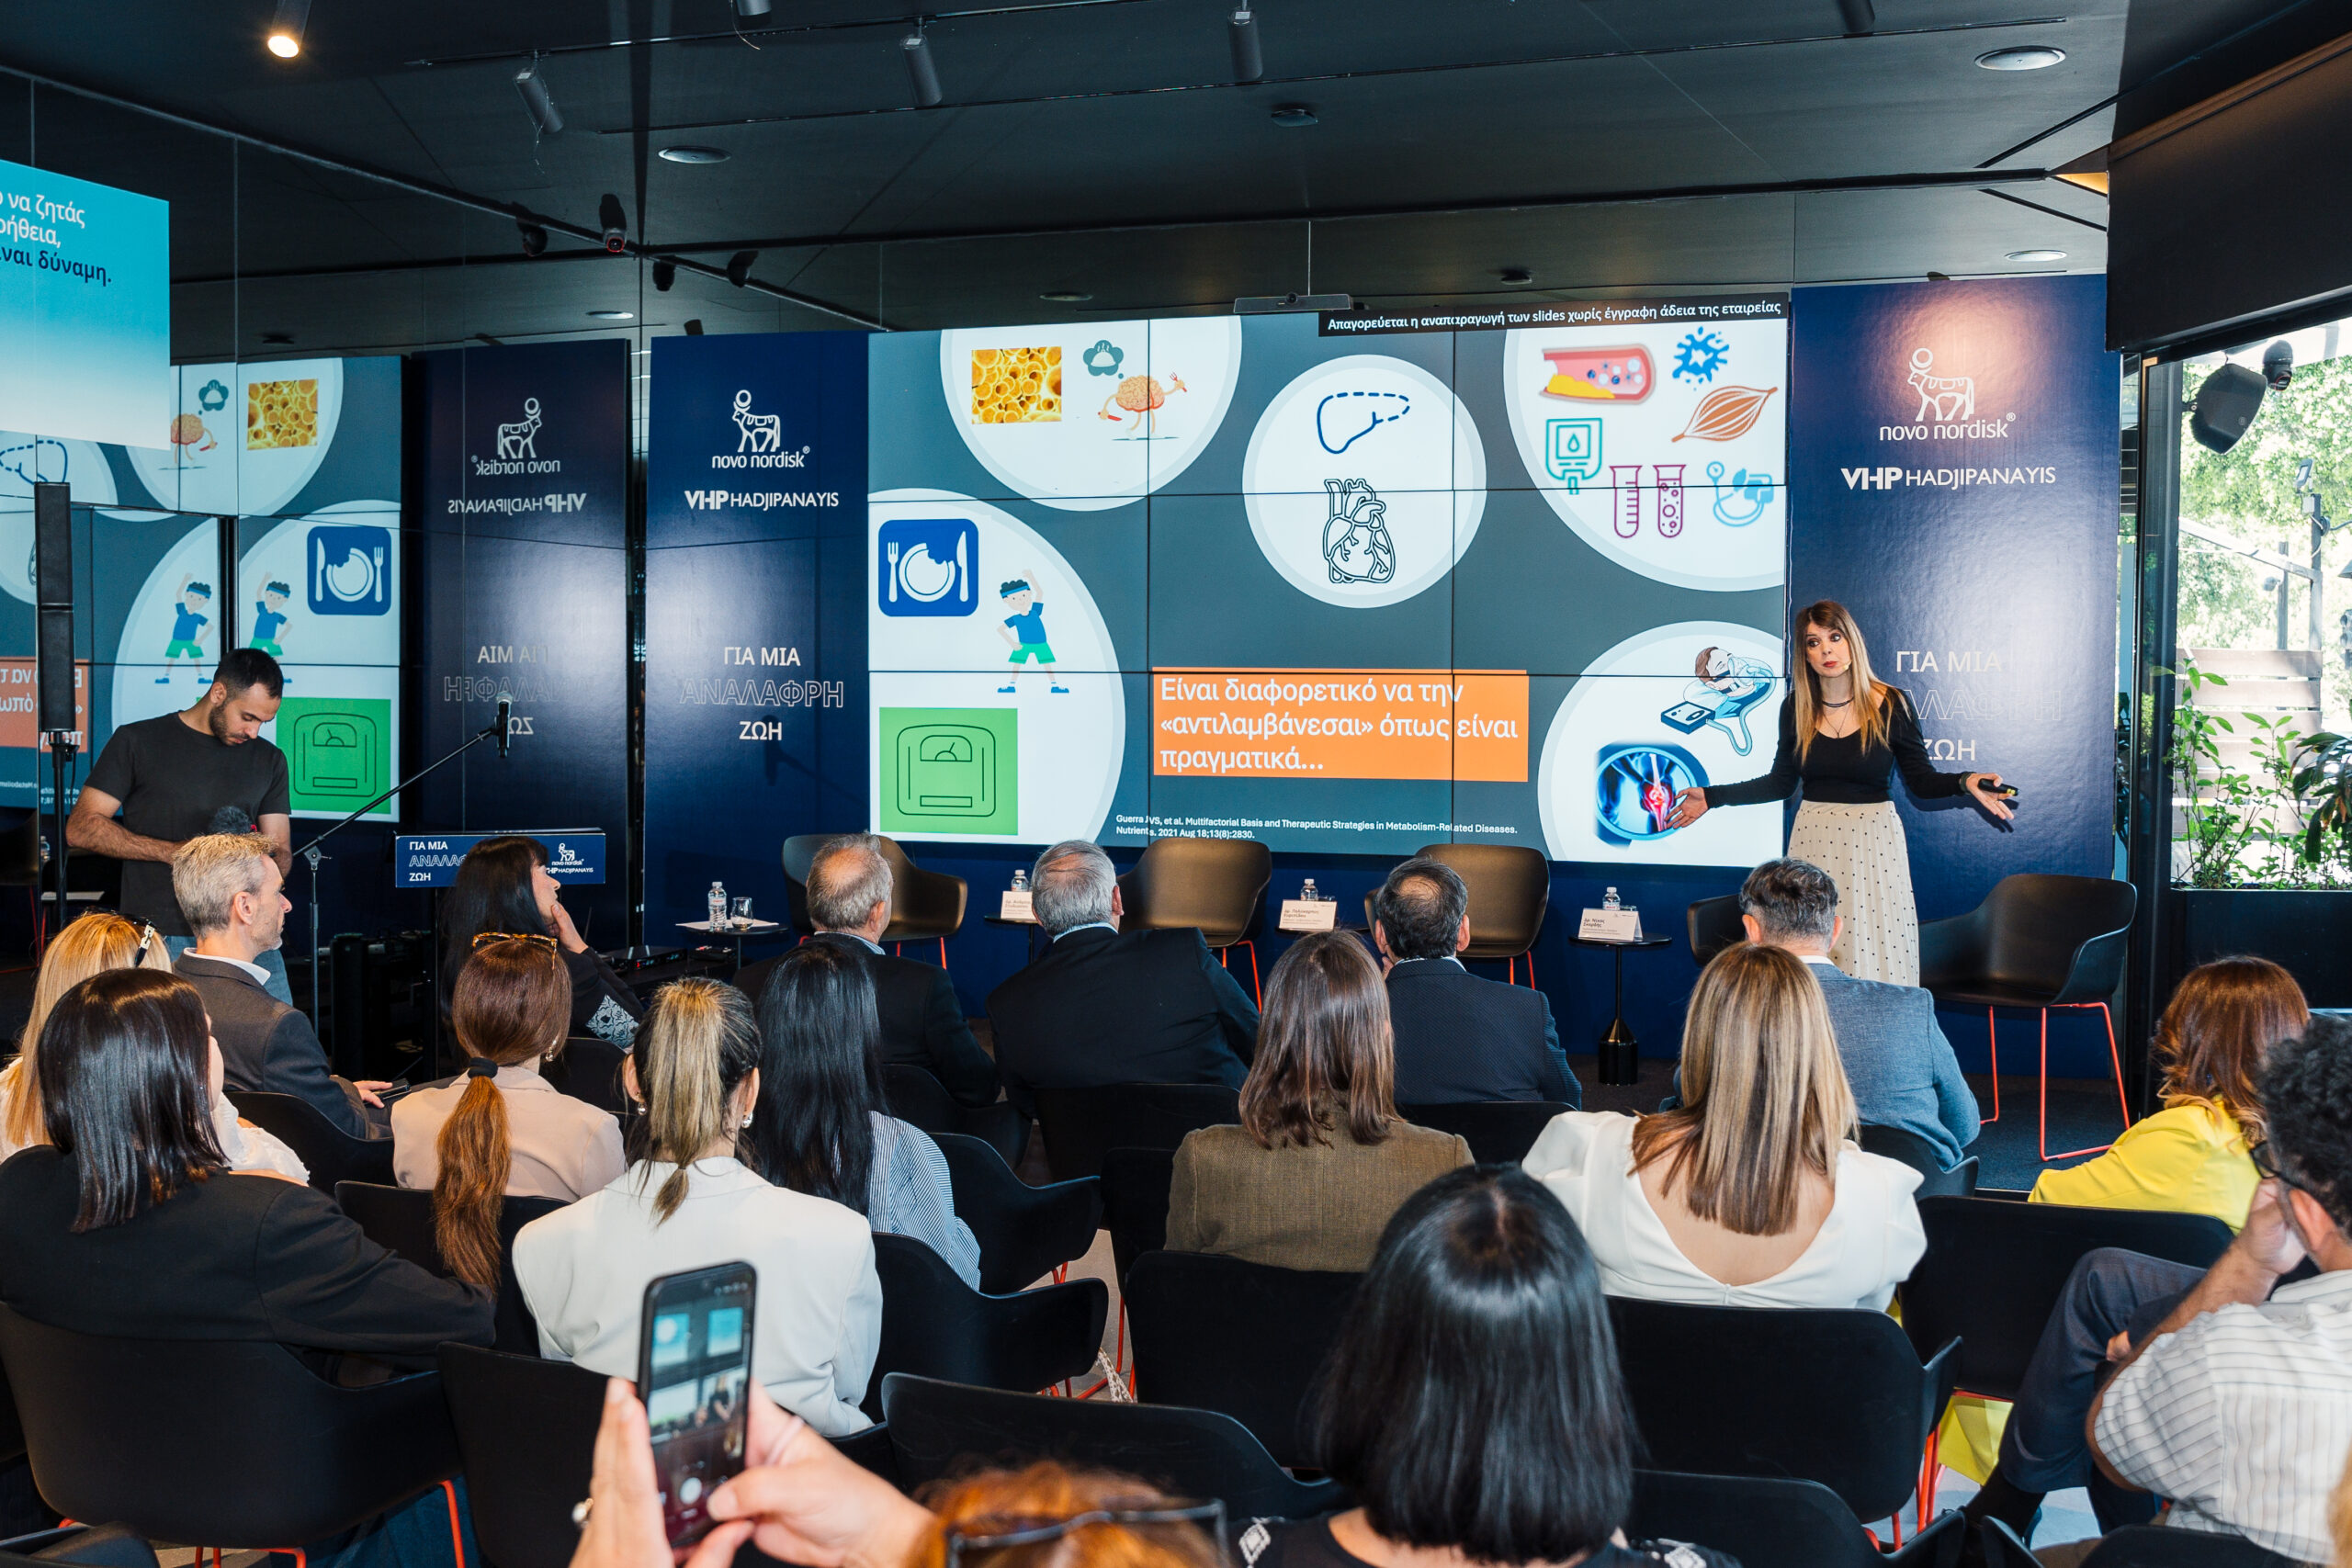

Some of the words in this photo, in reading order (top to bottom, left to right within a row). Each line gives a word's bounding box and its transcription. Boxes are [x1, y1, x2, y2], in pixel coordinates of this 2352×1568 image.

[7, 193, 31, 212] να
[35, 194, 85, 229] ζητάς
[0, 246, 33, 267] ναι
[39, 250, 112, 287] δύναμη.
[1328, 315, 1408, 332] Απαγορεύεται
[1410, 318, 1419, 330] η
[1420, 310, 1505, 328] αναπαραγωγή
[1508, 312, 1531, 322] των
[1532, 309, 1565, 321] slides
[1567, 307, 1601, 322] χωρίς
[1604, 306, 1657, 321] έγγραφη
[1660, 303, 1696, 317] άδεια
[1698, 305, 1719, 317] της
[1722, 300, 1781, 315] εταιρείας
[1880, 424, 1928, 441] novo
[712, 455, 747, 468] novo
[1840, 467, 1904, 491] VHP
[1905, 467, 2056, 491] HADJIPANAYIS
[684, 490, 729, 510] VHP
[730, 492, 839, 512] HADJIPANAYIS
[724, 647, 755, 665] ΓΙΑ
[761, 647, 801, 666] ΜΙΑ
[1896, 650, 1939, 672] ΓΙΑ
[1948, 650, 2002, 672] ΜΙΑ
[679, 678, 843, 708] ΑΝΑΛΑΦΡΗ
[1161, 678, 1219, 702] Είναι
[1225, 678, 1377, 706] διαφορετικό
[1383, 684, 1413, 702] να
[1419, 684, 1464, 707] την
[739, 721, 782, 740] ΖΩΗ
[1160, 713, 1374, 740] «αντιλαμβάνεσαι»
[1380, 713, 1450, 740] όπως
[1456, 715, 1518, 739] είναι
[1160, 746, 1324, 773] πραγματικά...
[1116, 814, 1144, 824] Guerra
[1164, 817, 1172, 825] et
[1173, 817, 1183, 826] al.
[1185, 818, 1239, 827] Multifactorial
[1241, 818, 1263, 828] Basis
[1264, 818, 1280, 828] and
[1282, 818, 1331, 830] Therapeutic
[1332, 820, 1374, 831] Strategies
[1376, 821, 1384, 830] in
[1385, 821, 1473, 832] Metabolism-Related
[1475, 824, 1518, 834] Diseases.
[1116, 826, 1157, 837] Nutrients.
[1158, 828, 1178, 838] 2021
[1180, 829, 1195, 840] Aug
[409, 841, 426, 851] ΓΙΑ
[428, 840, 448, 851] ΜΙΑ
[409, 854, 467, 867] ΑΝΑΛΑ
[409, 872, 431, 882] ΖΩΗ
